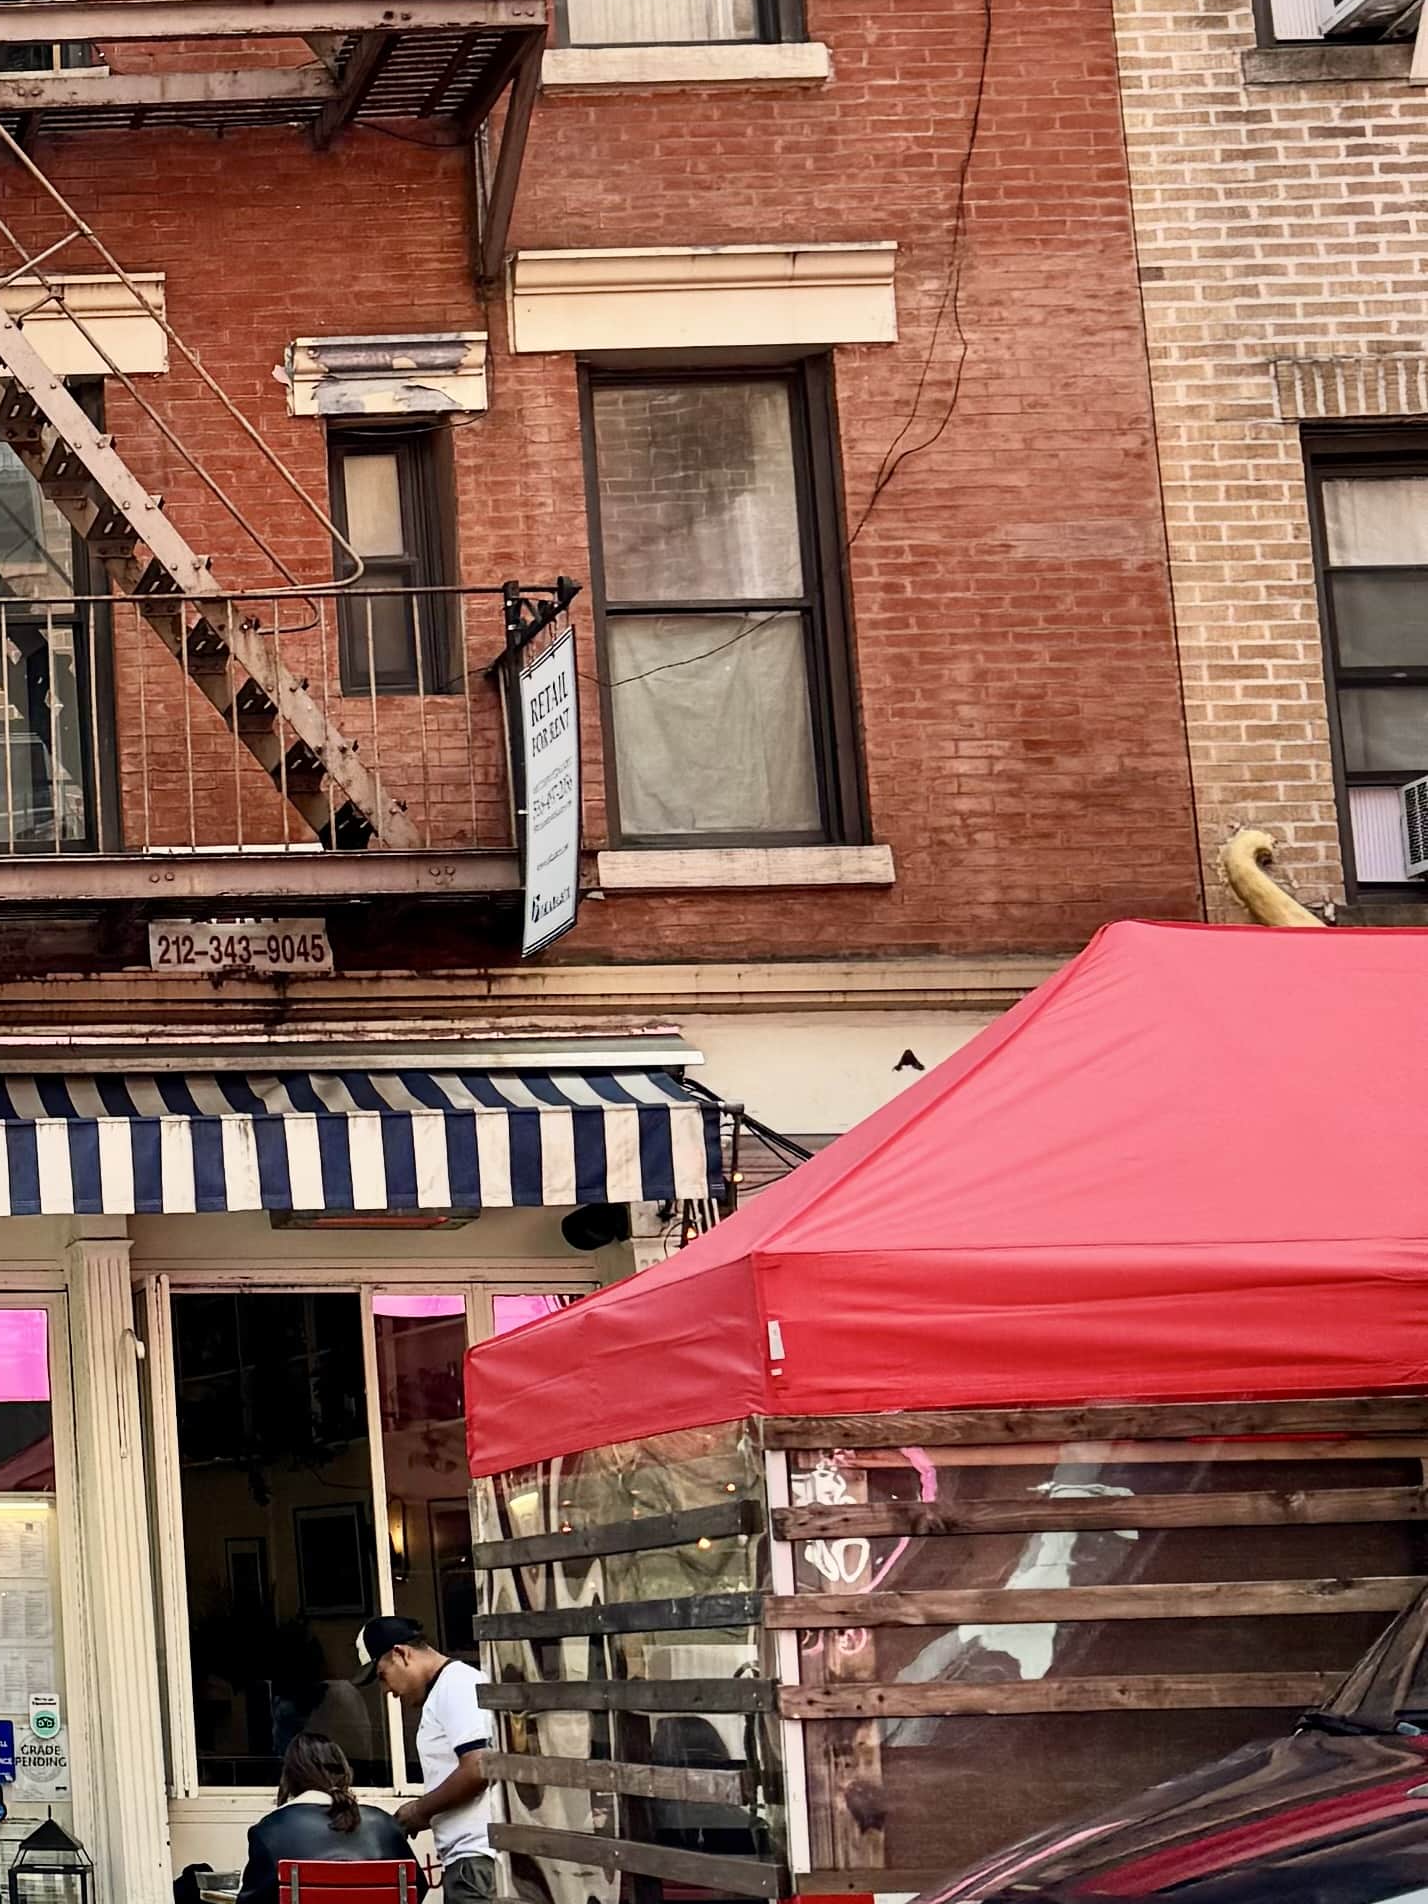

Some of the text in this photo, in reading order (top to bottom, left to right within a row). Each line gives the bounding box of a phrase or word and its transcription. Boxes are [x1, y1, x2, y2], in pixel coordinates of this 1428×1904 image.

[530, 672, 568, 727] RETAIL
[531, 707, 570, 758] FOR RENT
[157, 933, 325, 965] 212-343-9045
[15, 1756, 67, 1768] PENDING
[20, 1744, 61, 1756] GRADE
